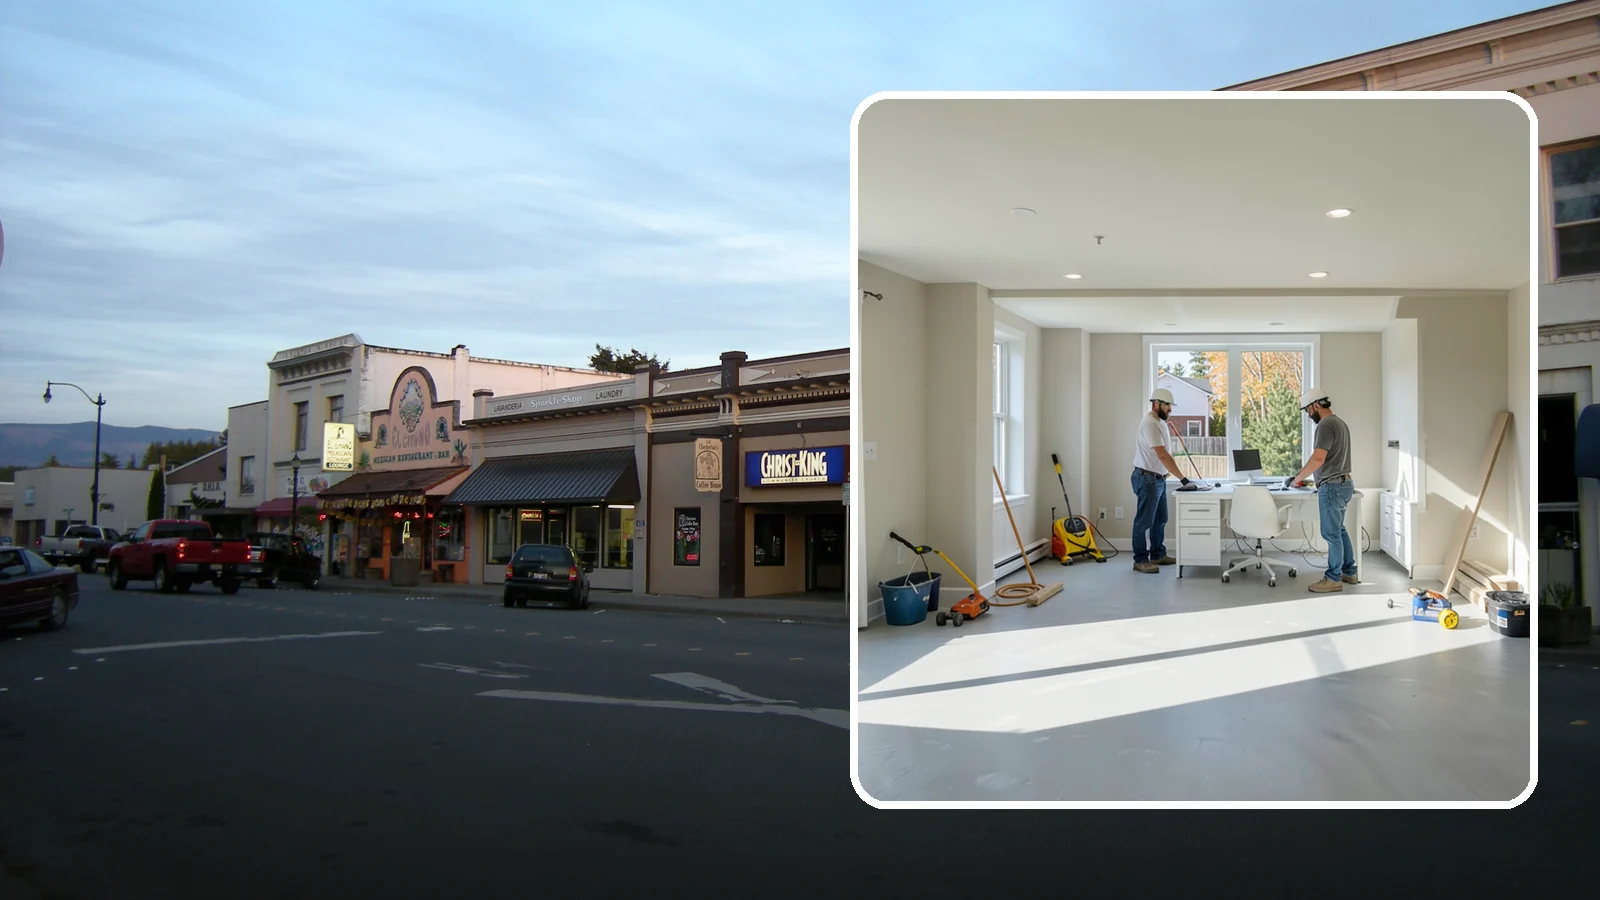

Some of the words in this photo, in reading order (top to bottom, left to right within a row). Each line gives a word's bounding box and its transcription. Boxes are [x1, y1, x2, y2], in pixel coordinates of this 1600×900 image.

[493, 401, 523, 413] LAVANDERIA
[561, 394, 583, 405] Shop
[595, 388, 624, 400] LAUNDRY
[391, 426, 401, 449] EL
[373, 455, 397, 464] MEXICAN
[397, 452, 433, 463] RESTAURANT
[438, 450, 450, 459] BAR
[761, 452, 798, 478] CHRIST
[799, 450, 828, 477] KING
[710, 481, 721, 489] House
